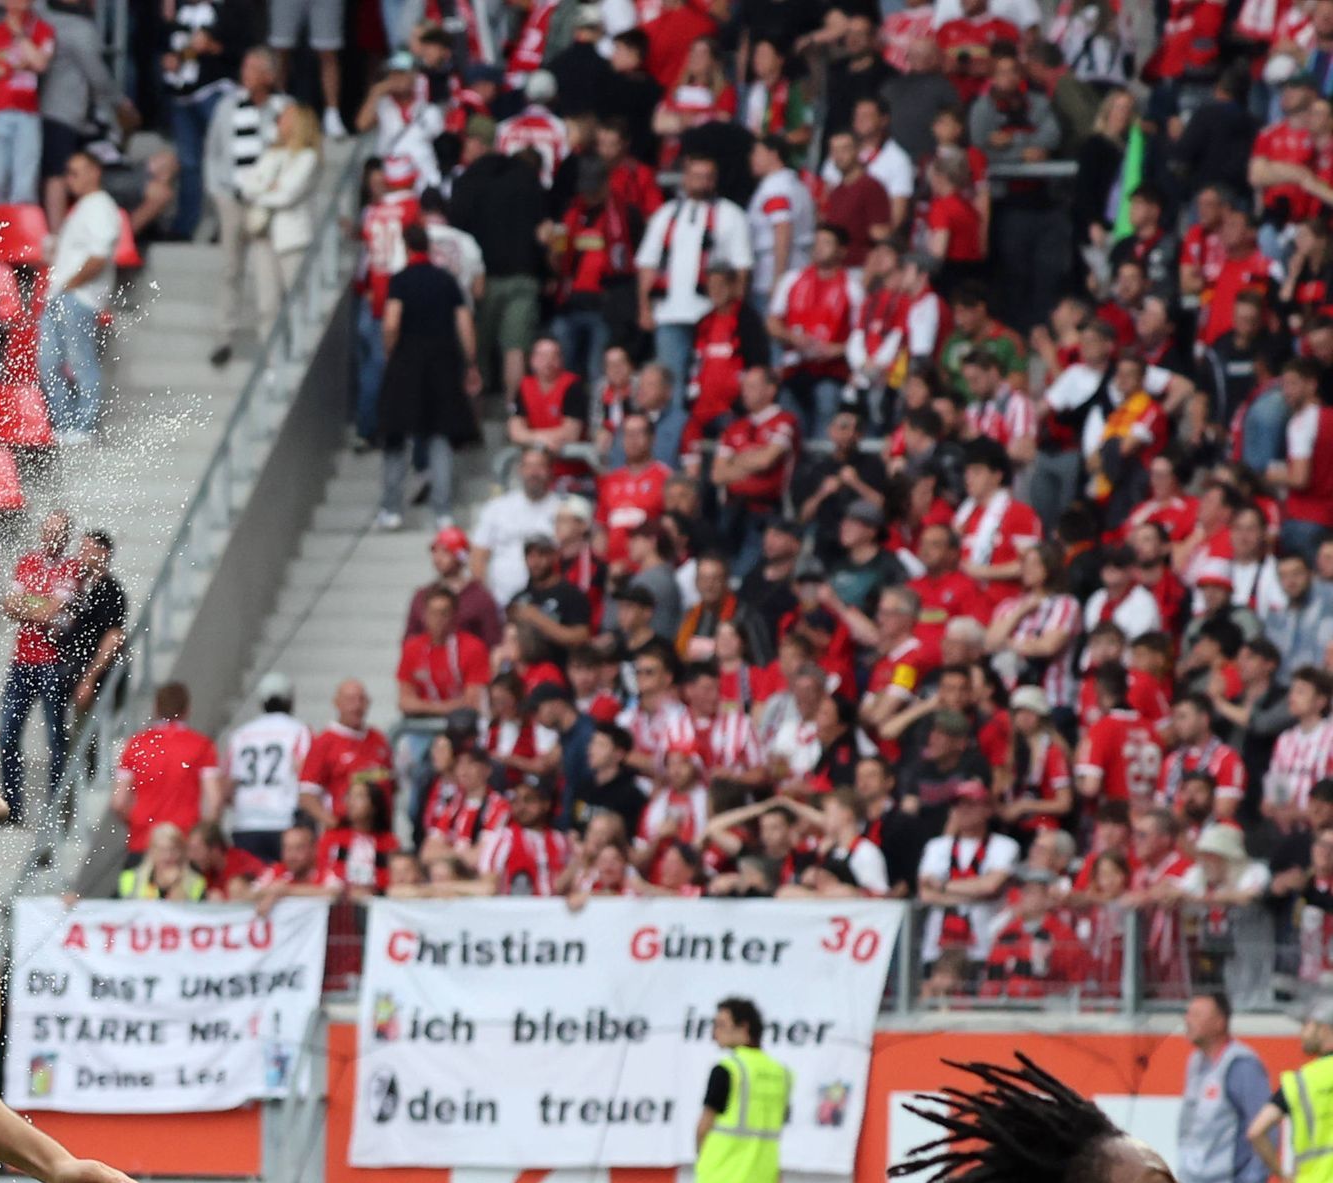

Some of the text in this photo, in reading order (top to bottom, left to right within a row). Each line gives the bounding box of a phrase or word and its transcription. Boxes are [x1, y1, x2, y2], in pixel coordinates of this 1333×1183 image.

[240, 743, 284, 787] 32
[387, 915, 880, 966] Christian Günter 30
[409, 1007, 474, 1042] ich
[514, 1008, 650, 1043] bleibe
[407, 1088, 676, 1125] dein treuer
